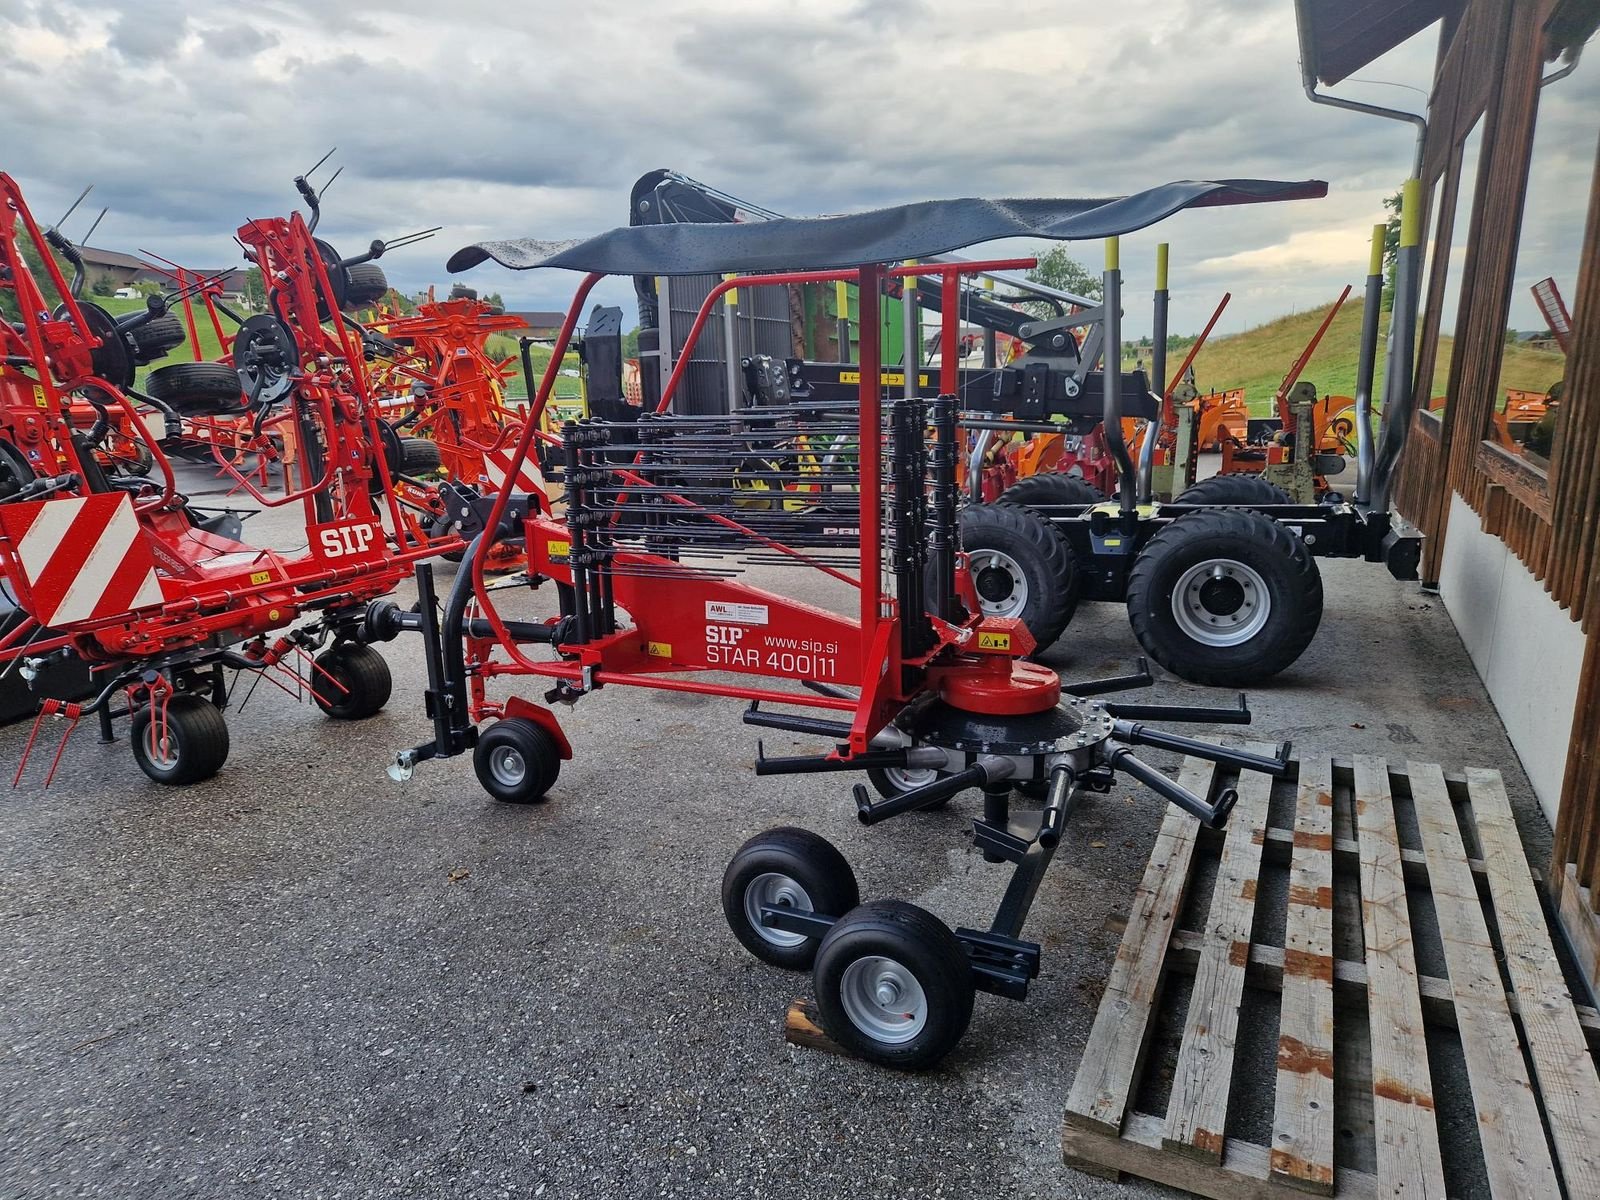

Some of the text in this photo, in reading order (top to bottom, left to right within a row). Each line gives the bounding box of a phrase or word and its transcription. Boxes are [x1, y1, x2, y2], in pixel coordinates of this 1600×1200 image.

[320, 523, 374, 558] SIP
[710, 605, 728, 613] AWL
[705, 625, 743, 645] SIP
[764, 635, 838, 654] www.sip.si
[706, 645, 760, 668] STAR
